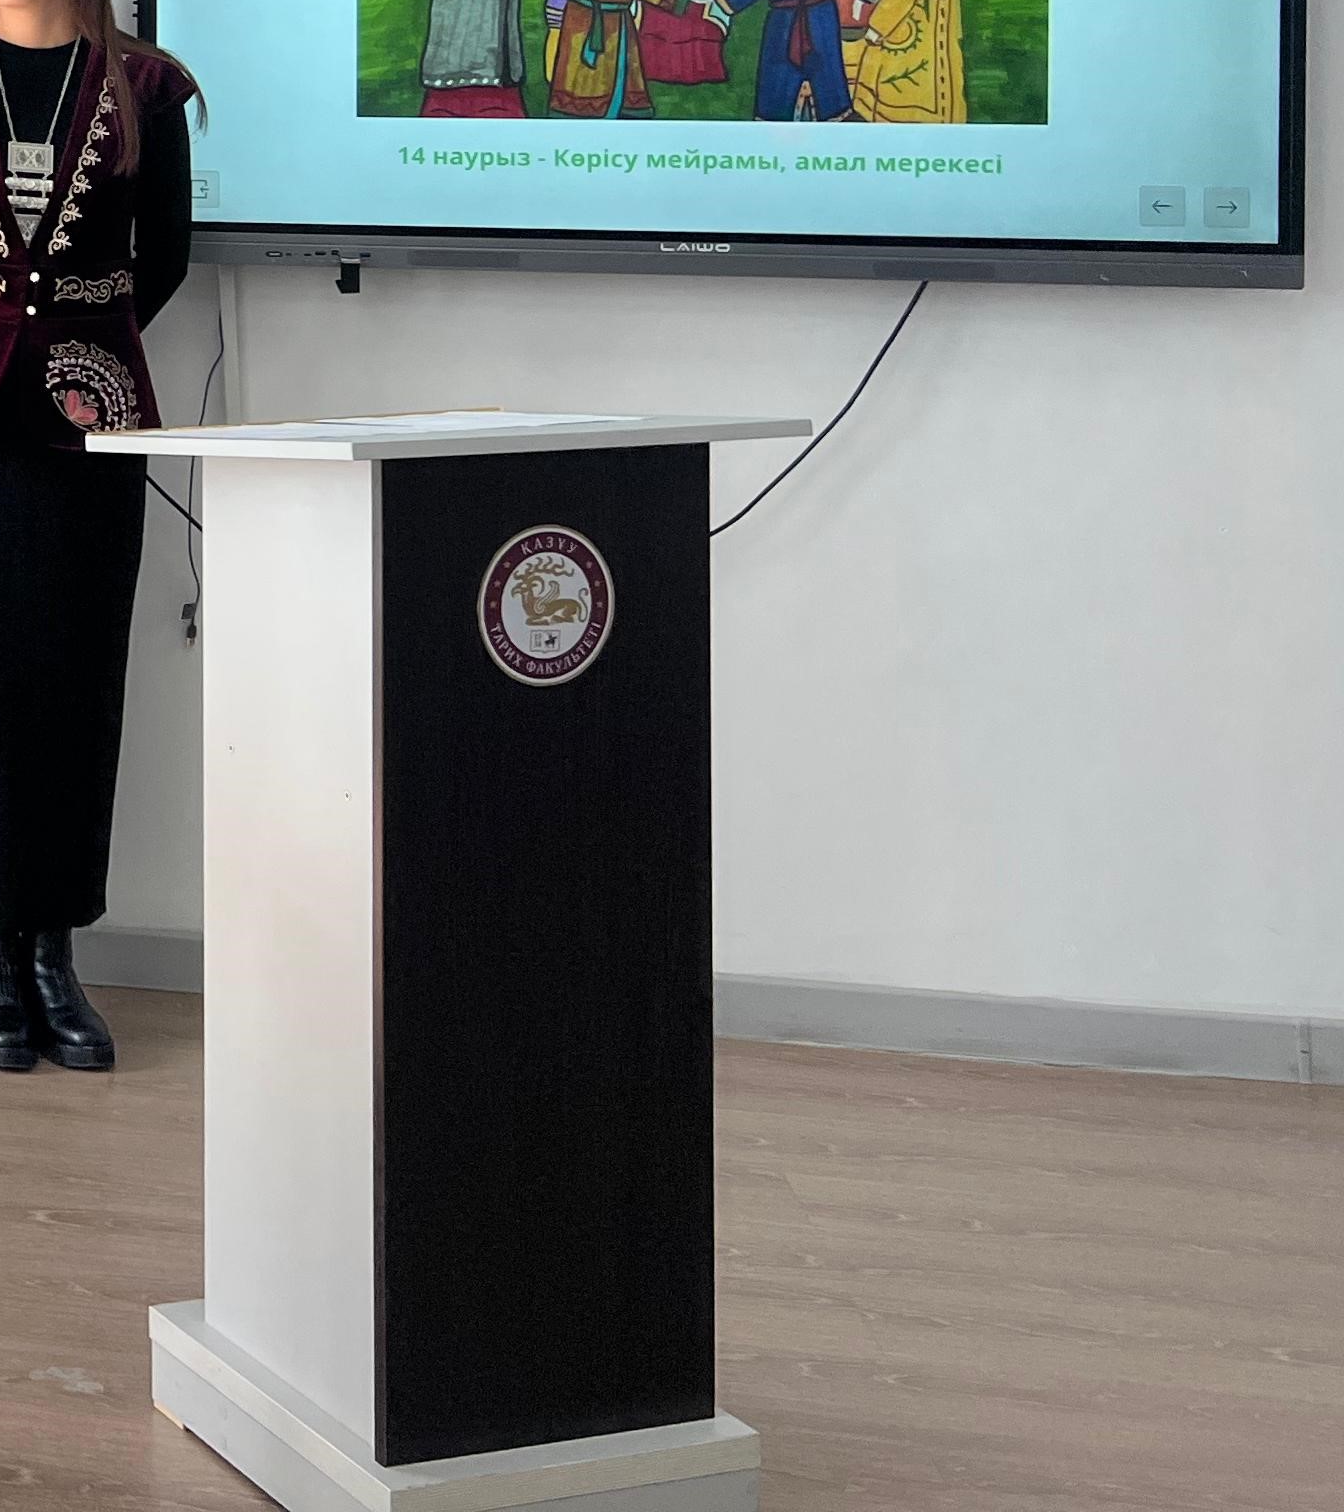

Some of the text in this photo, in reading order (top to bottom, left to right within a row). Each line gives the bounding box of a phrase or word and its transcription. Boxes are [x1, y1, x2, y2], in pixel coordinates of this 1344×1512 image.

[398, 147, 425, 165] 14
[433, 150, 530, 171] наурыз
[554, 149, 638, 174] Көрісу
[647, 149, 786, 175] мейрамы,
[795, 154, 866, 172] амал
[875, 154, 1002, 178] мерекесі
[490, 622, 601, 675] ТАРИХ ФАКУЛЬТЕТІ
